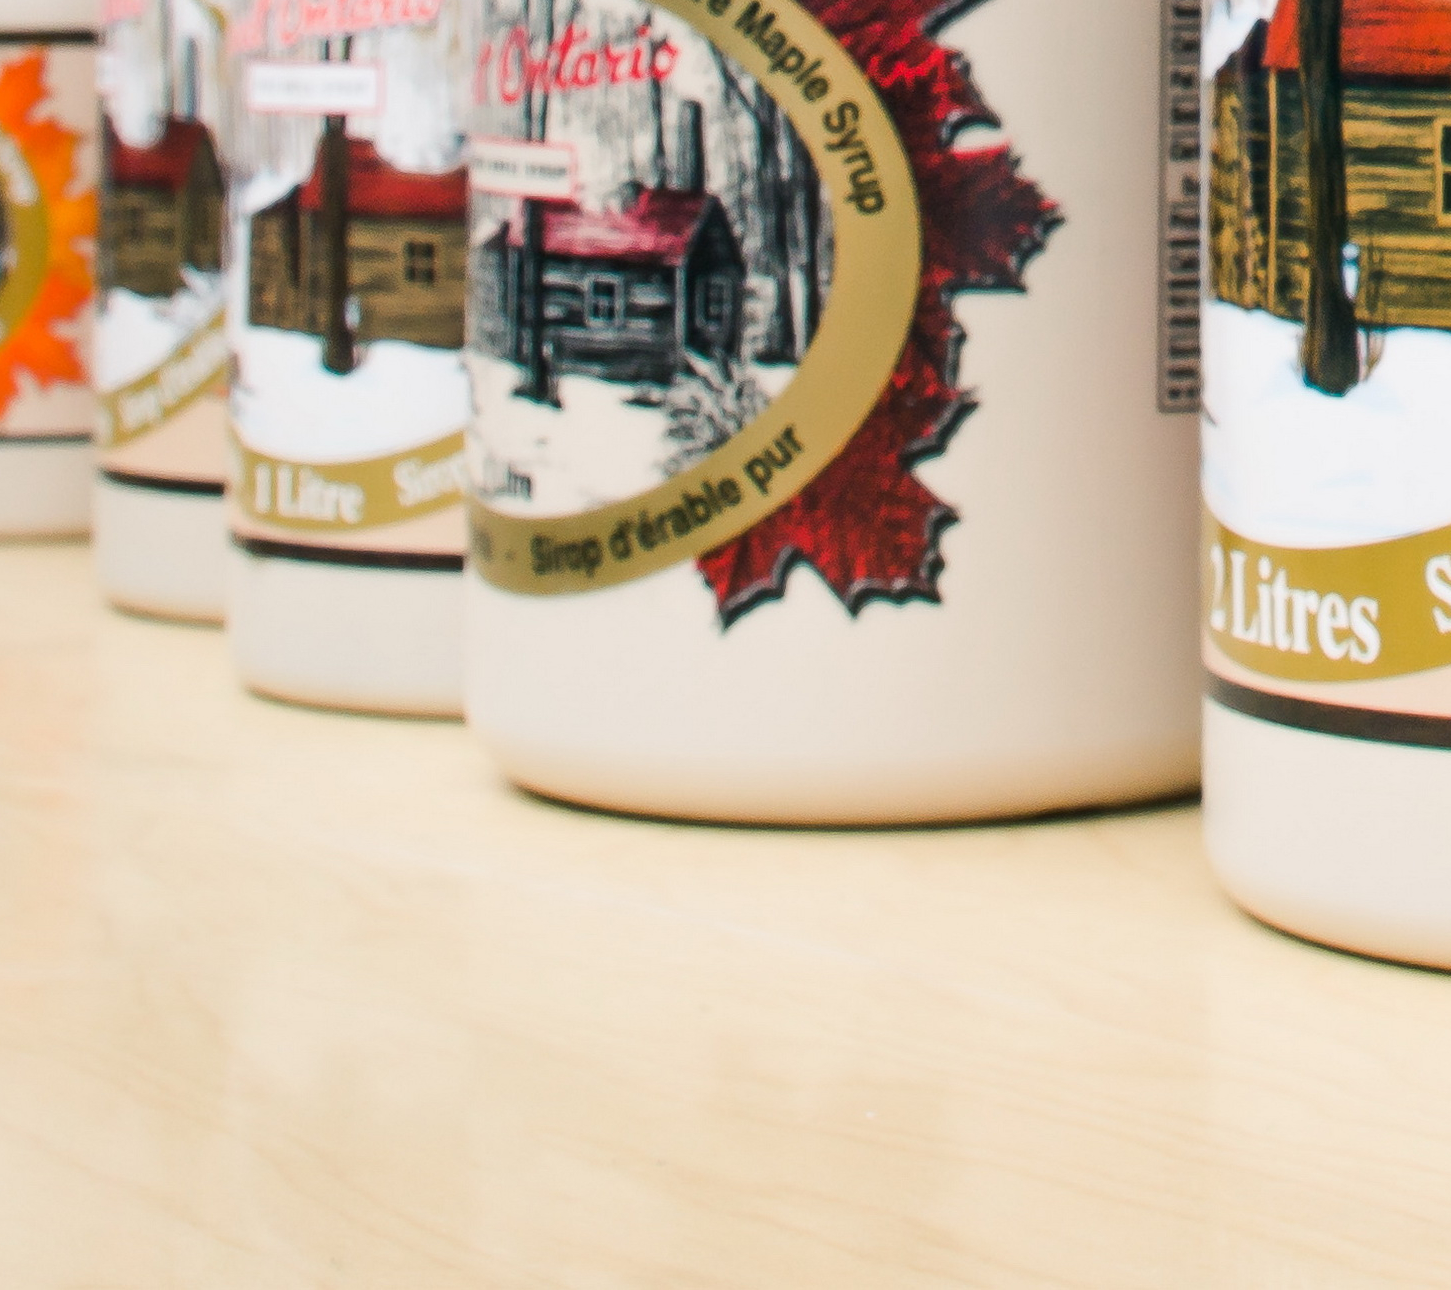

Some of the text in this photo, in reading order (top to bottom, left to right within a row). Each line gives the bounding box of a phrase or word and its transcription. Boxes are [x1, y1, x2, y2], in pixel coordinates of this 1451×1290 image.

[499, 22, 680, 107] Ontario
[732, 0, 830, 104] Maple
[821, 99, 887, 215] Syrup
[530, 533, 603, 578] Sirop
[743, 422, 804, 497] pur
[1231, 547, 1382, 666] Litres
